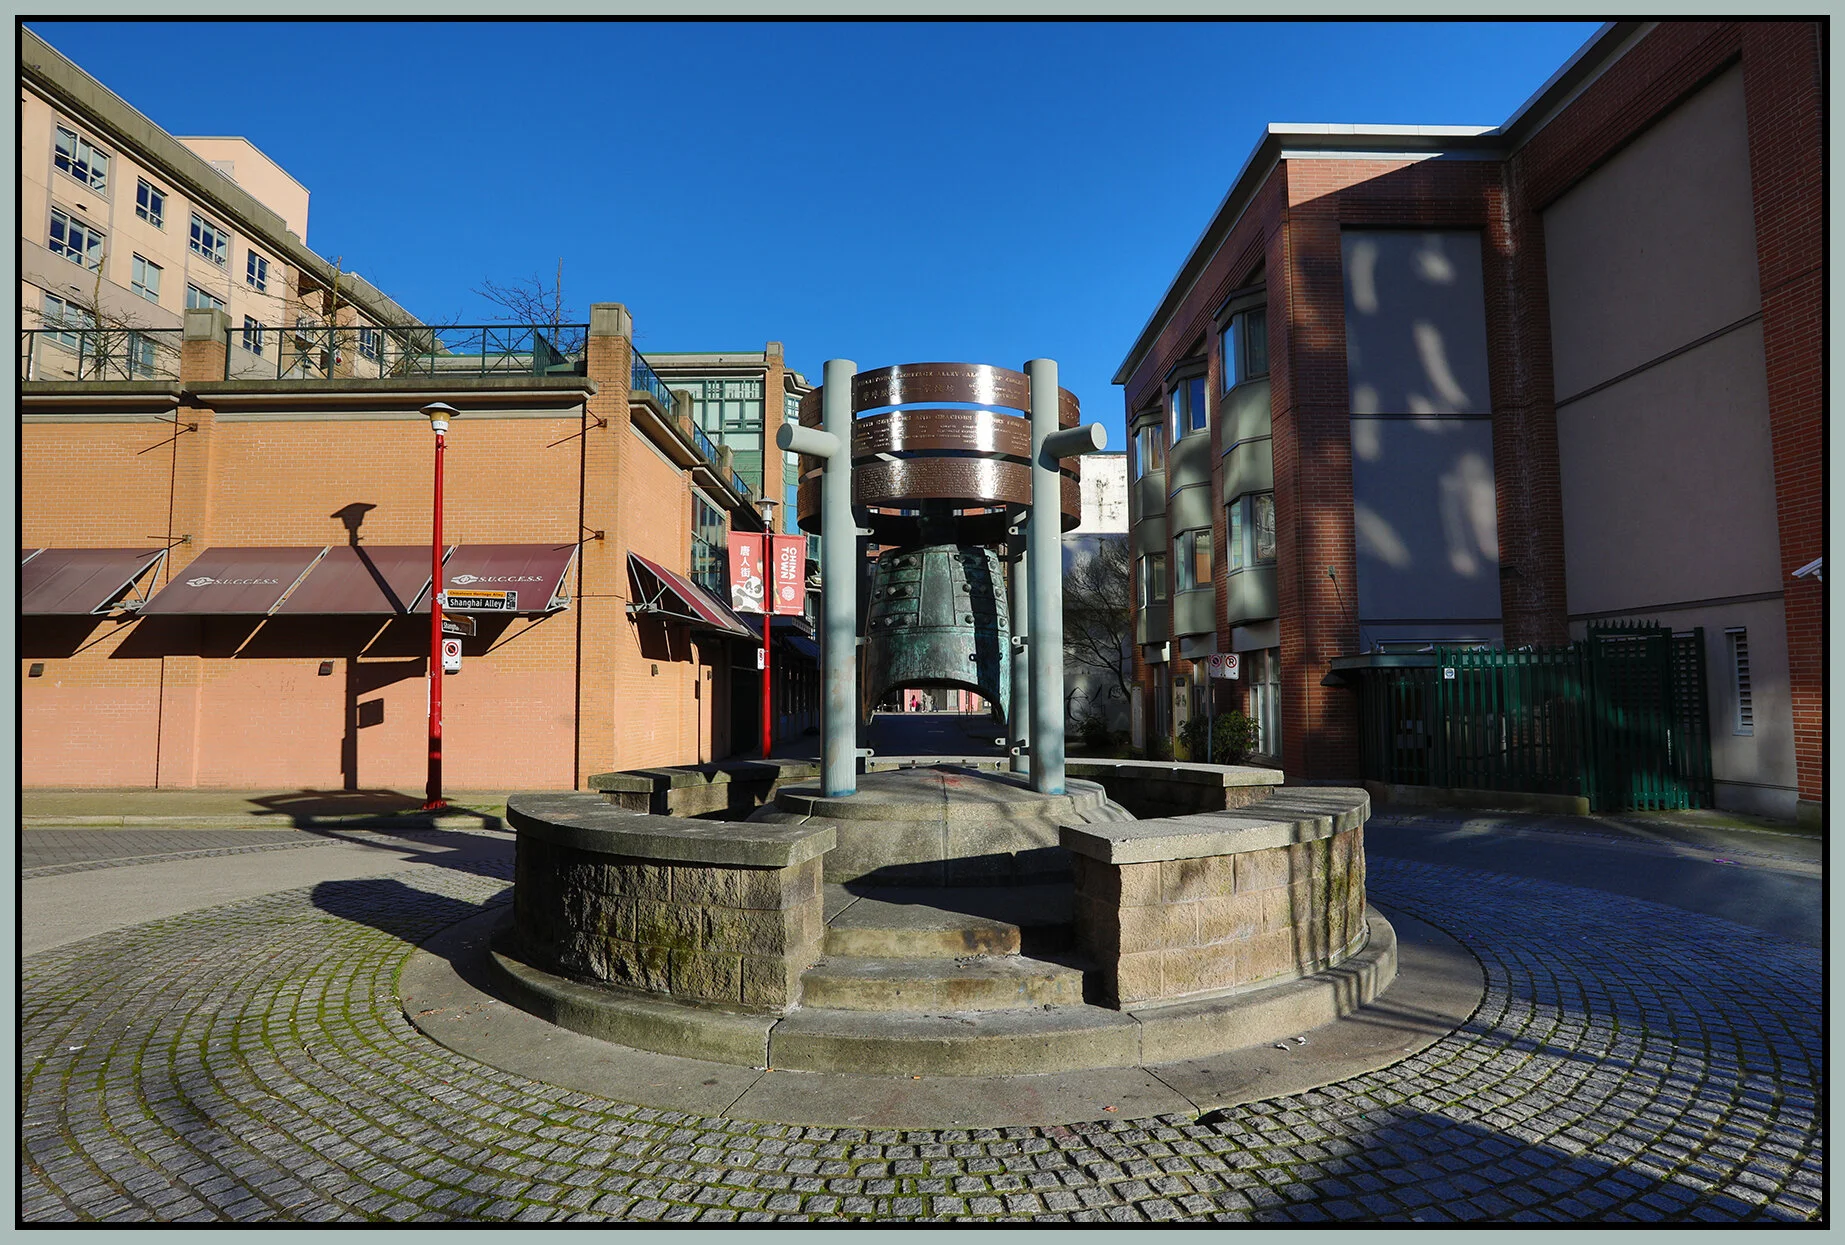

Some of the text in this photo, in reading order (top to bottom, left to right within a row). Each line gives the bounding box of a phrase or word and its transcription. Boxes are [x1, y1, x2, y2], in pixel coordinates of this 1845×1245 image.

[740, 545, 751, 578] 唐人街
[781, 547, 790, 580] TOWN
[789, 547, 798, 580] CHINA
[450, 598, 483, 609] Shanghai
[484, 599, 503, 610] Alley
